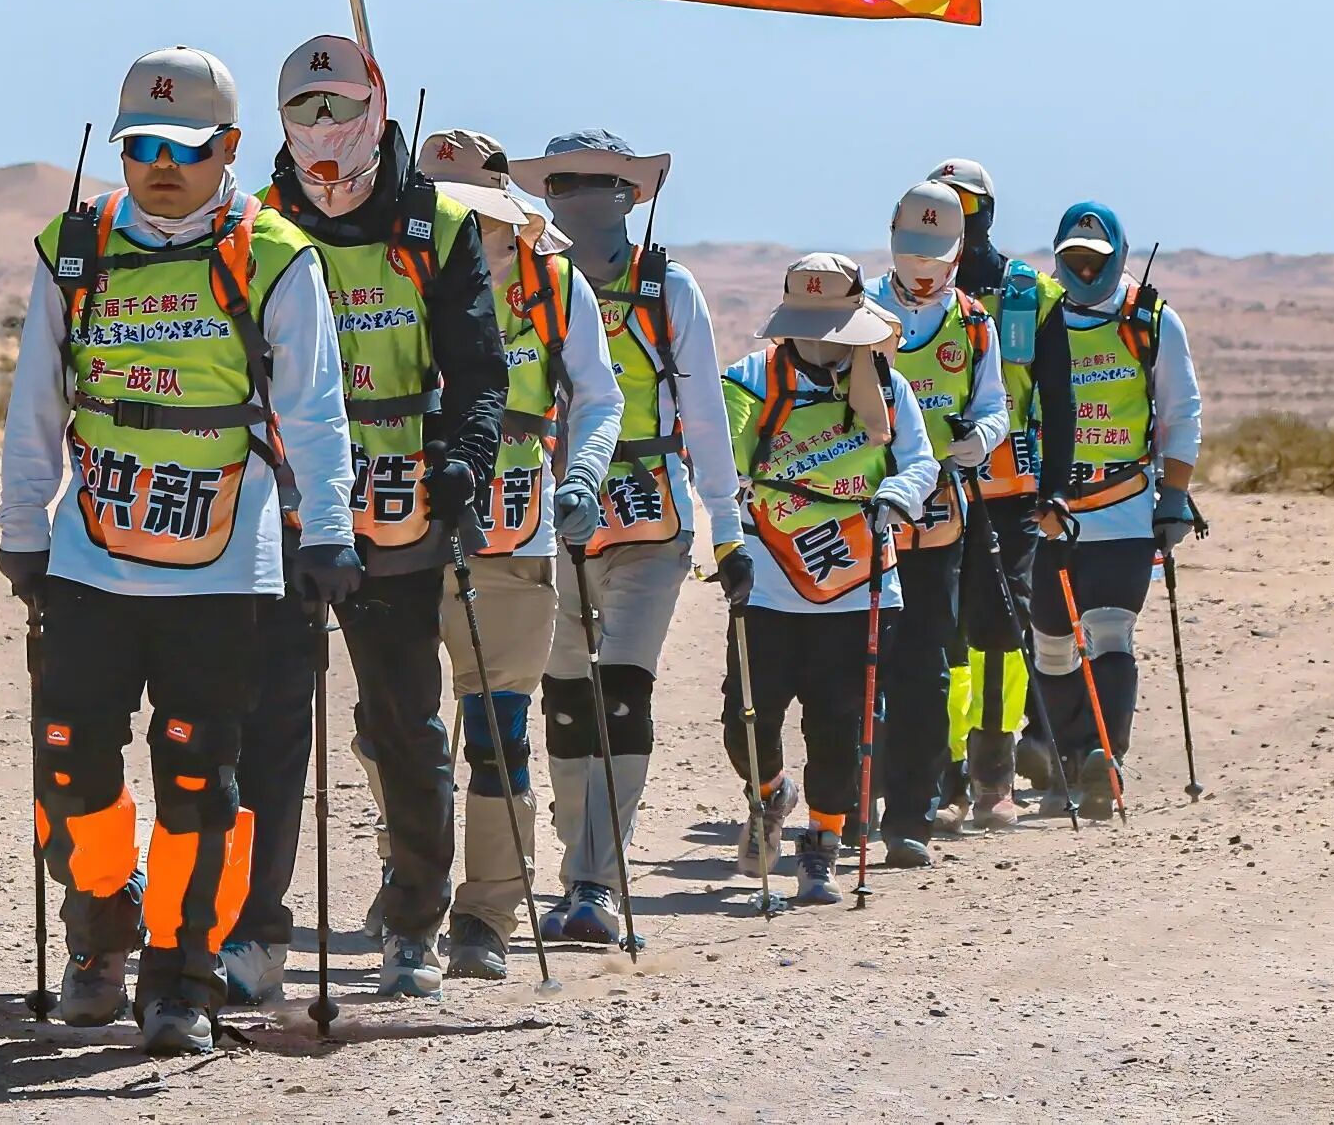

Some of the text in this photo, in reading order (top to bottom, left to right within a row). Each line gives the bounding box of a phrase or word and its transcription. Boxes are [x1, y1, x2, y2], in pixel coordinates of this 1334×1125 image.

[85, 357, 183, 397] 第一战队
[1078, 402, 1111, 420] 战队
[73, 438, 223, 540] 洪新
[793, 516, 859, 585] 吴
